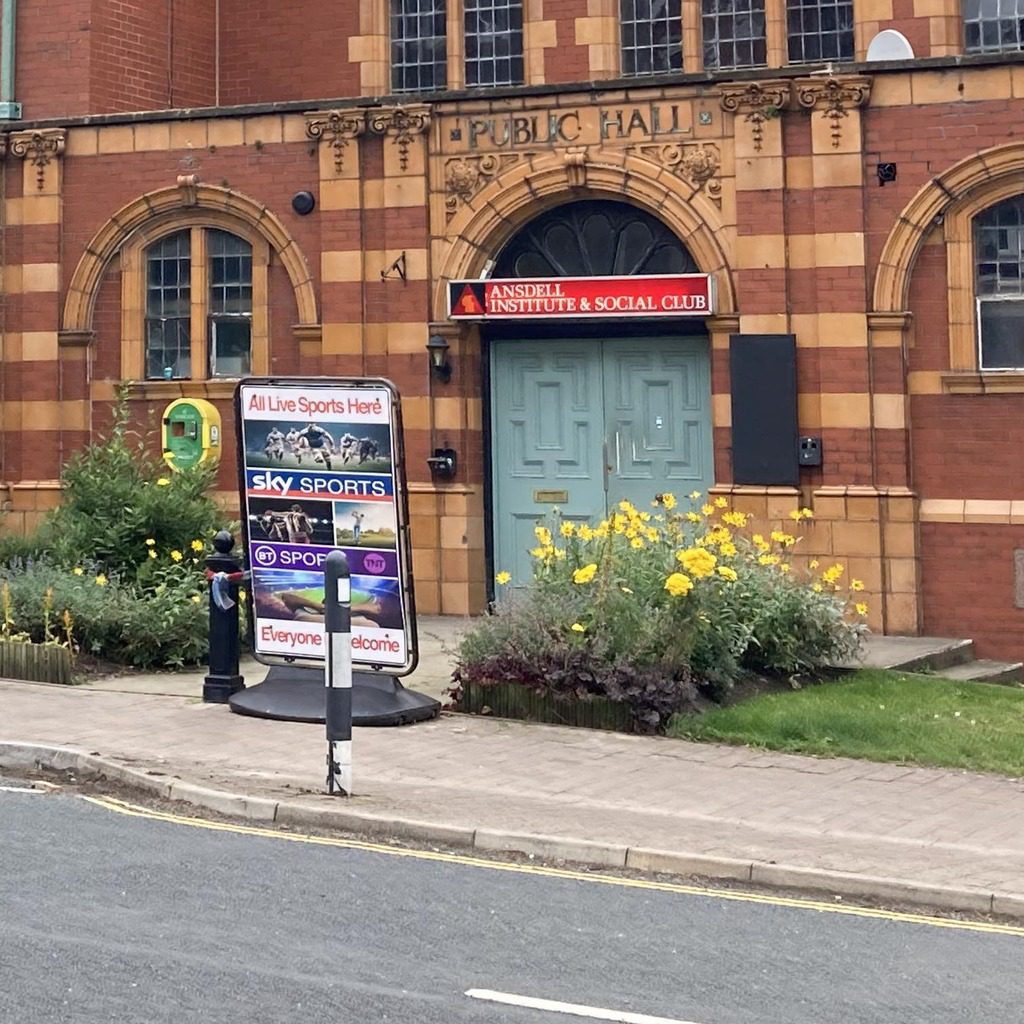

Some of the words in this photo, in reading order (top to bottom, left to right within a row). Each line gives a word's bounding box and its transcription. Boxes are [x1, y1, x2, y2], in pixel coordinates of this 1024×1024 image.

[469, 110, 582, 148] PUBLIC
[601, 105, 691, 139] HALL
[490, 283, 565, 299] ANSDELL
[490, 297, 577, 313] INSTITUTE
[579, 297, 592, 311] &
[594, 296, 658, 312] SOCIAL
[661, 294, 707, 309] CLUB
[249, 395, 266, 411] All
[268, 396, 296, 413] Live
[298, 396, 345, 417] Sports
[347, 397, 382, 414] Here
[252, 471, 293, 496] sky
[300, 477, 386, 497] SPORTS
[258, 551, 274, 561] BT
[261, 626, 322, 647] Everyone
[350, 634, 400, 653] elcome
